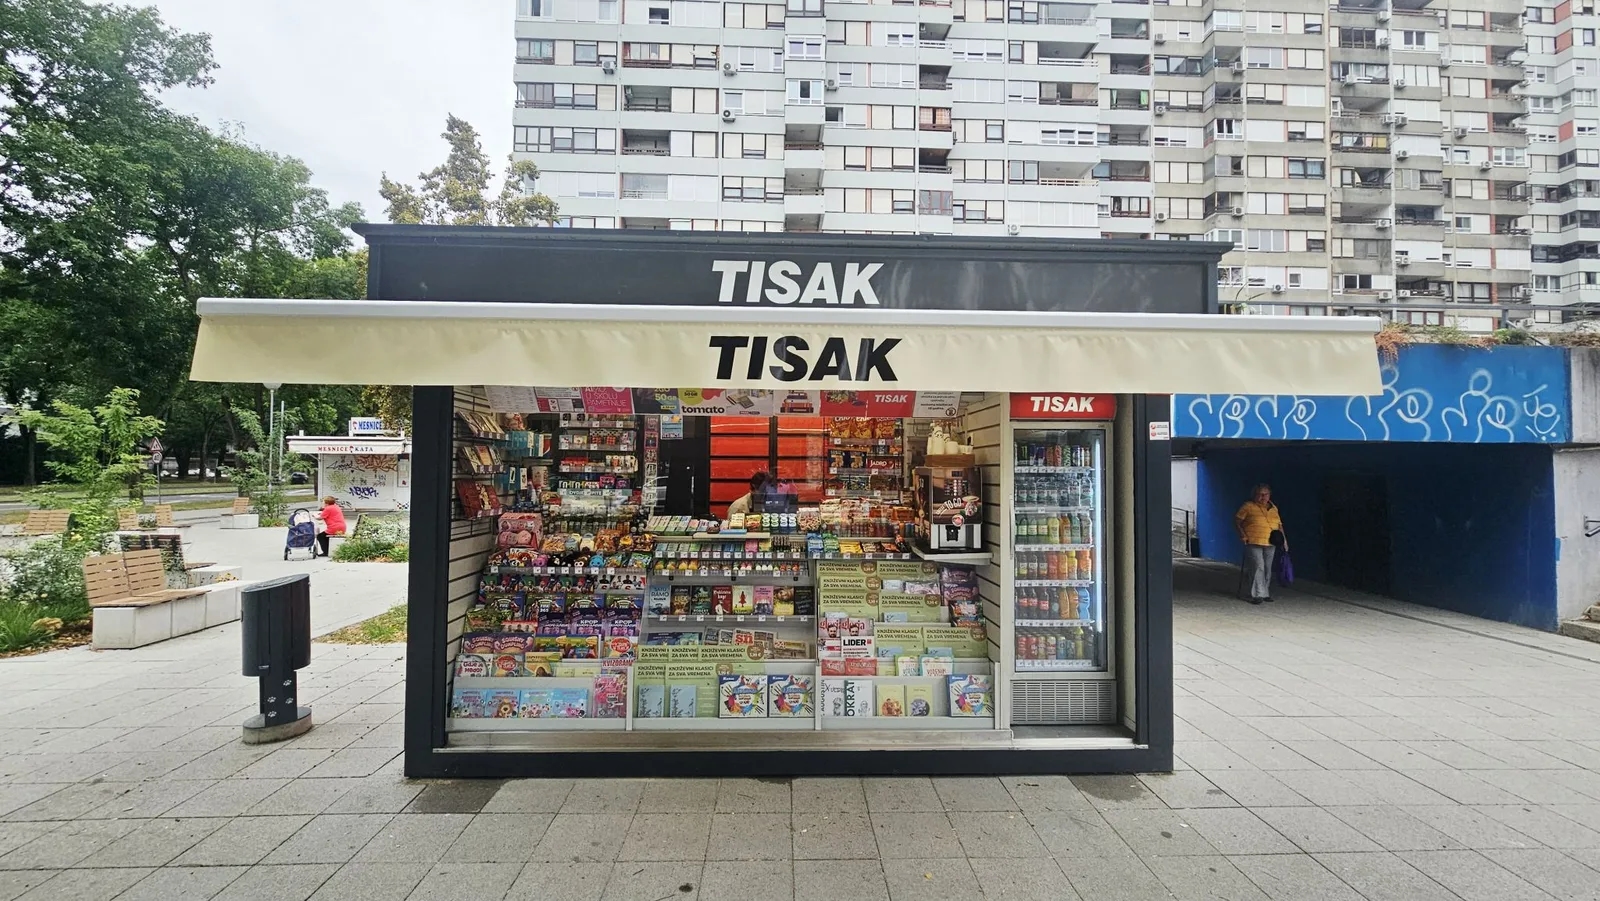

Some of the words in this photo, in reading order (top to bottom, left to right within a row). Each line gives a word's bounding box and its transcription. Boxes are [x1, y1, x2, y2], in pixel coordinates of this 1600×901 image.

[711, 260, 884, 305] TISAK
[708, 335, 903, 382] TISAK
[593, 390, 618, 399] ŠKOLU
[655, 393, 667, 401] 50
[874, 394, 908, 403] TISAK
[587, 399, 627, 407] PAMETNIJE
[1030, 396, 1094, 412] TISAK
[681, 405, 725, 414] tomato
[953, 497, 962, 508] GO
